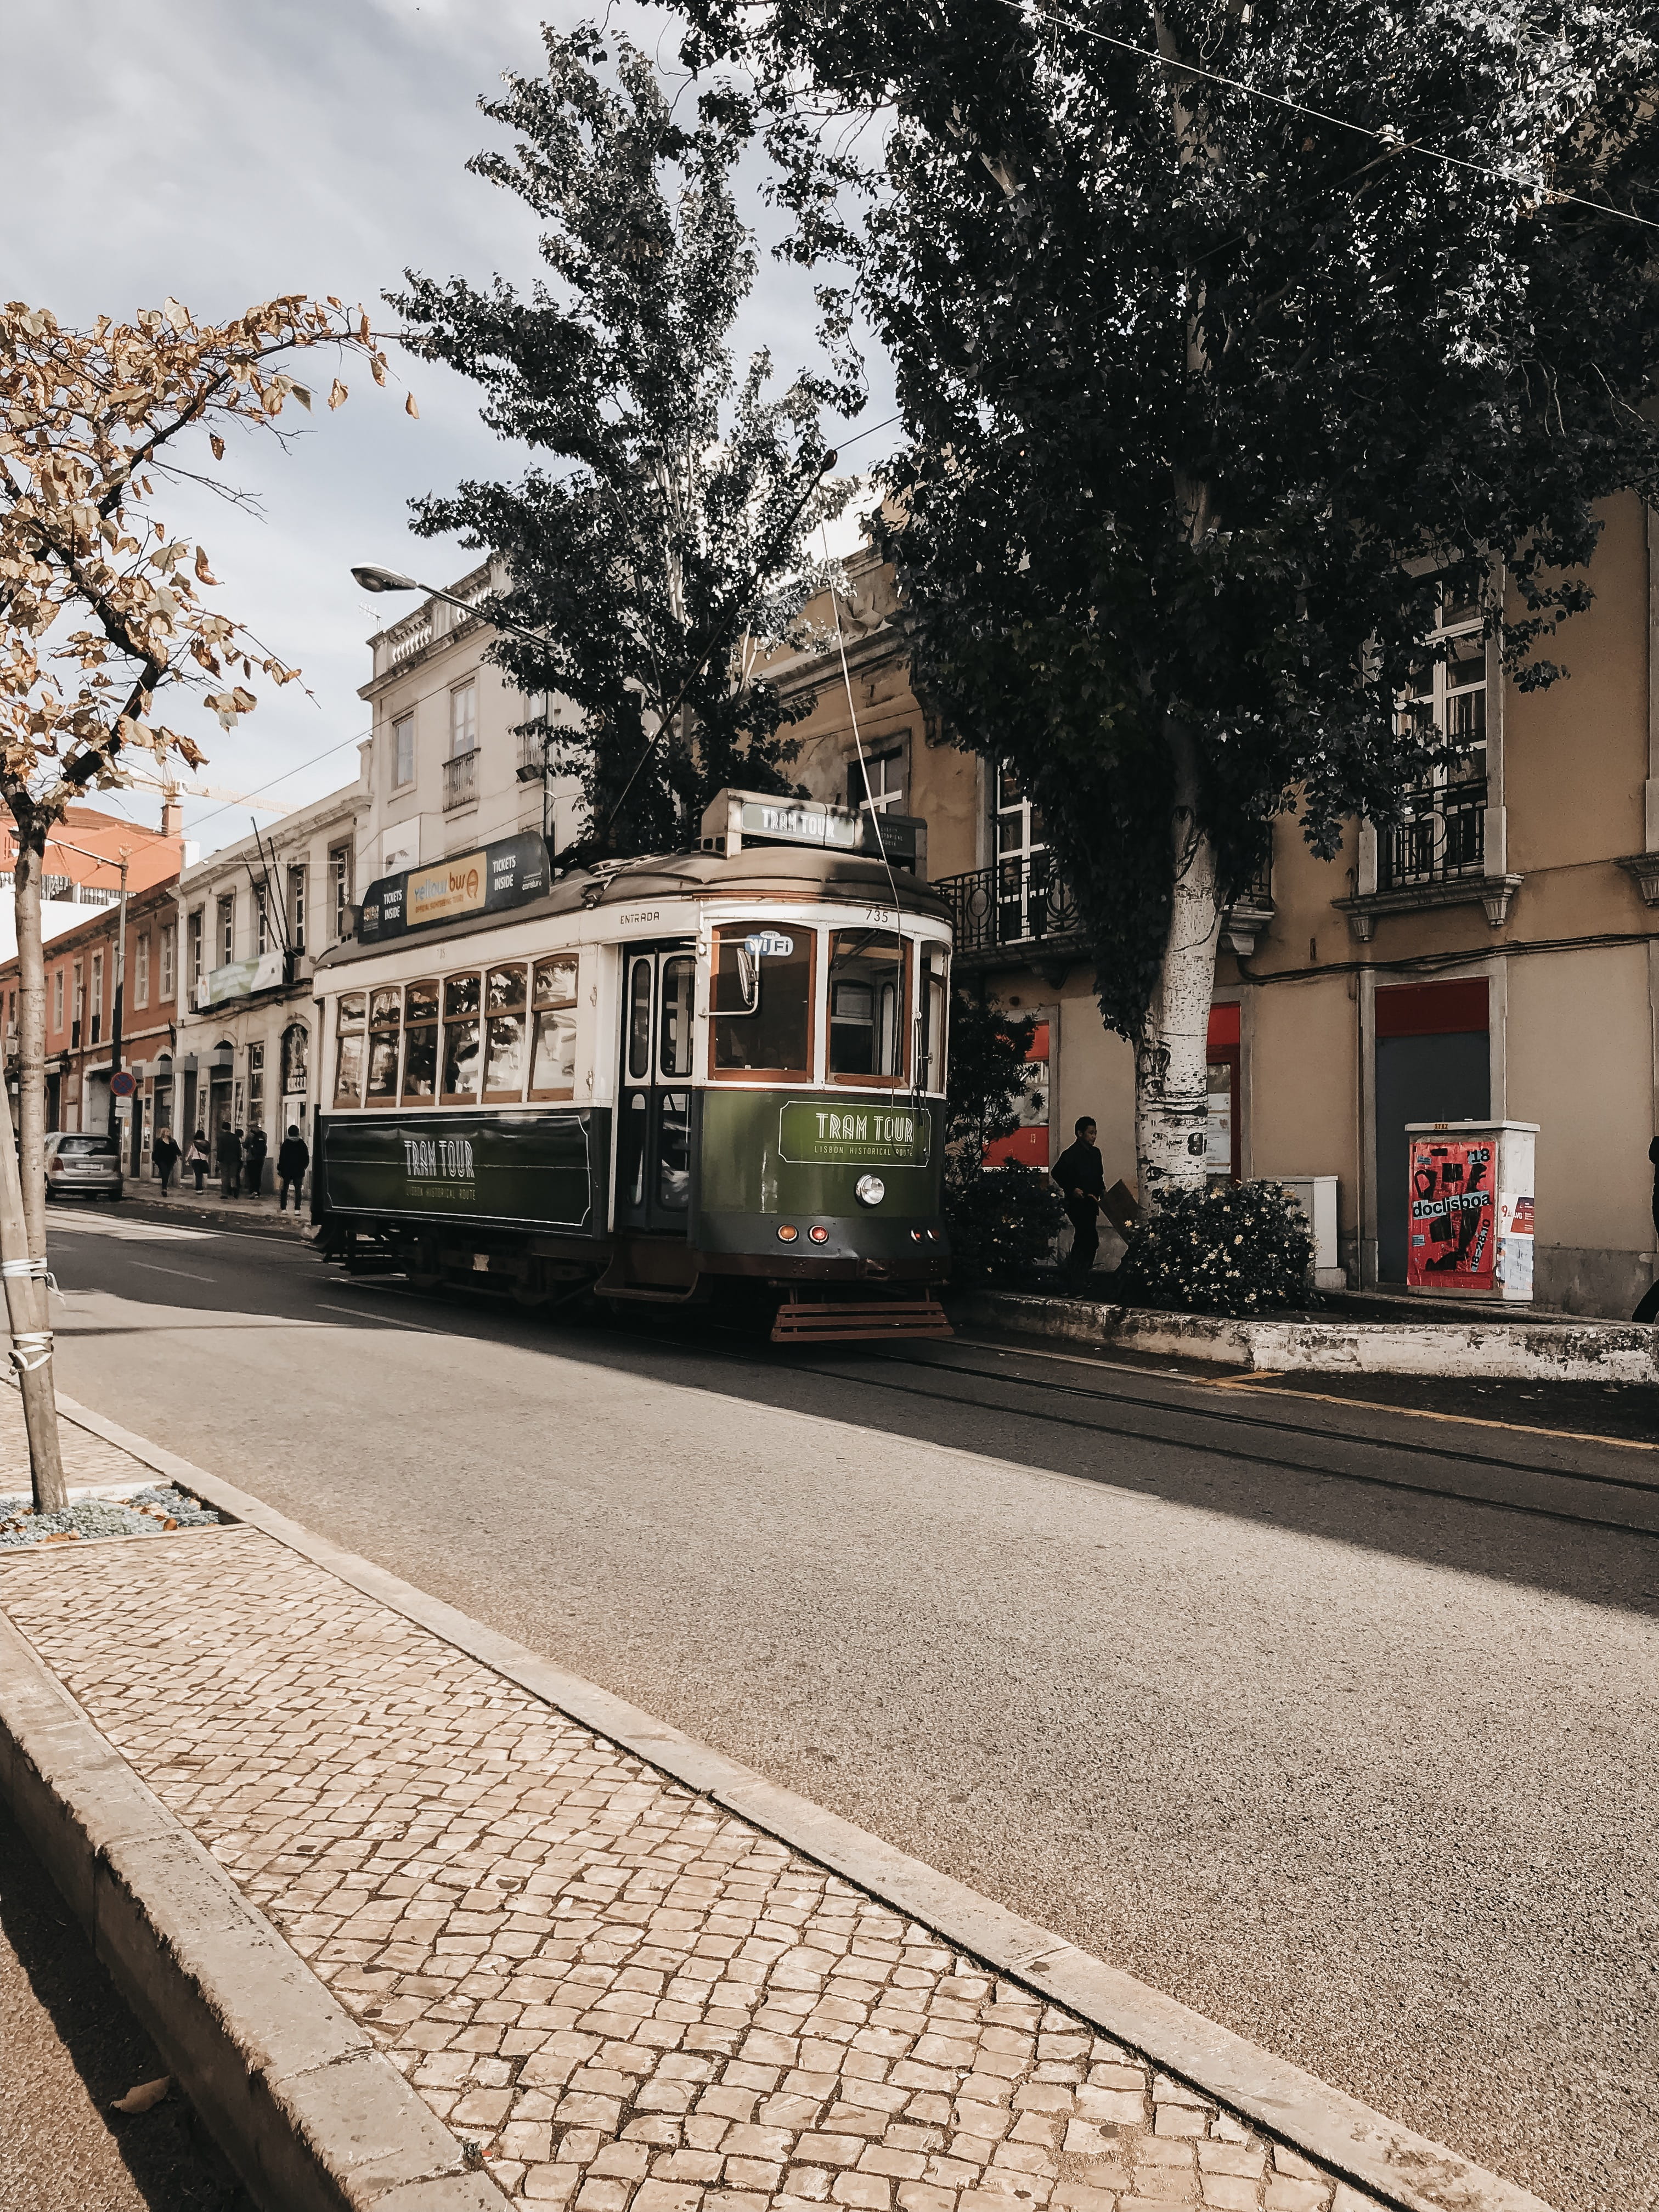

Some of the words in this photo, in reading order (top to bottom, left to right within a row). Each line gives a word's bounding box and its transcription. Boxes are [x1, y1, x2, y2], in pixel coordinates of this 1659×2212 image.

[762, 809, 797, 832] TRAM
[800, 815, 835, 838] TOUR
[493, 855, 516, 873] TICKETS
[414, 878, 448, 902] yellow
[449, 871, 466, 892] bus
[494, 874, 514, 891] INSIDE
[384, 889, 403, 905] TICKETS
[385, 906, 400, 921] INSIDE
[620, 912, 659, 924] ENTRADA
[866, 909, 889, 923] 735
[816, 1113, 867, 1141] TRAM
[873, 1115, 913, 1143] TOUR
[404, 1140, 437, 1176] TRAM
[439, 1141, 475, 1178] TOUR
[814, 1146, 843, 1154] LISBON
[850, 1147, 891, 1155] HISTORICAL
[1413, 1193, 1493, 1218] doclisboa
